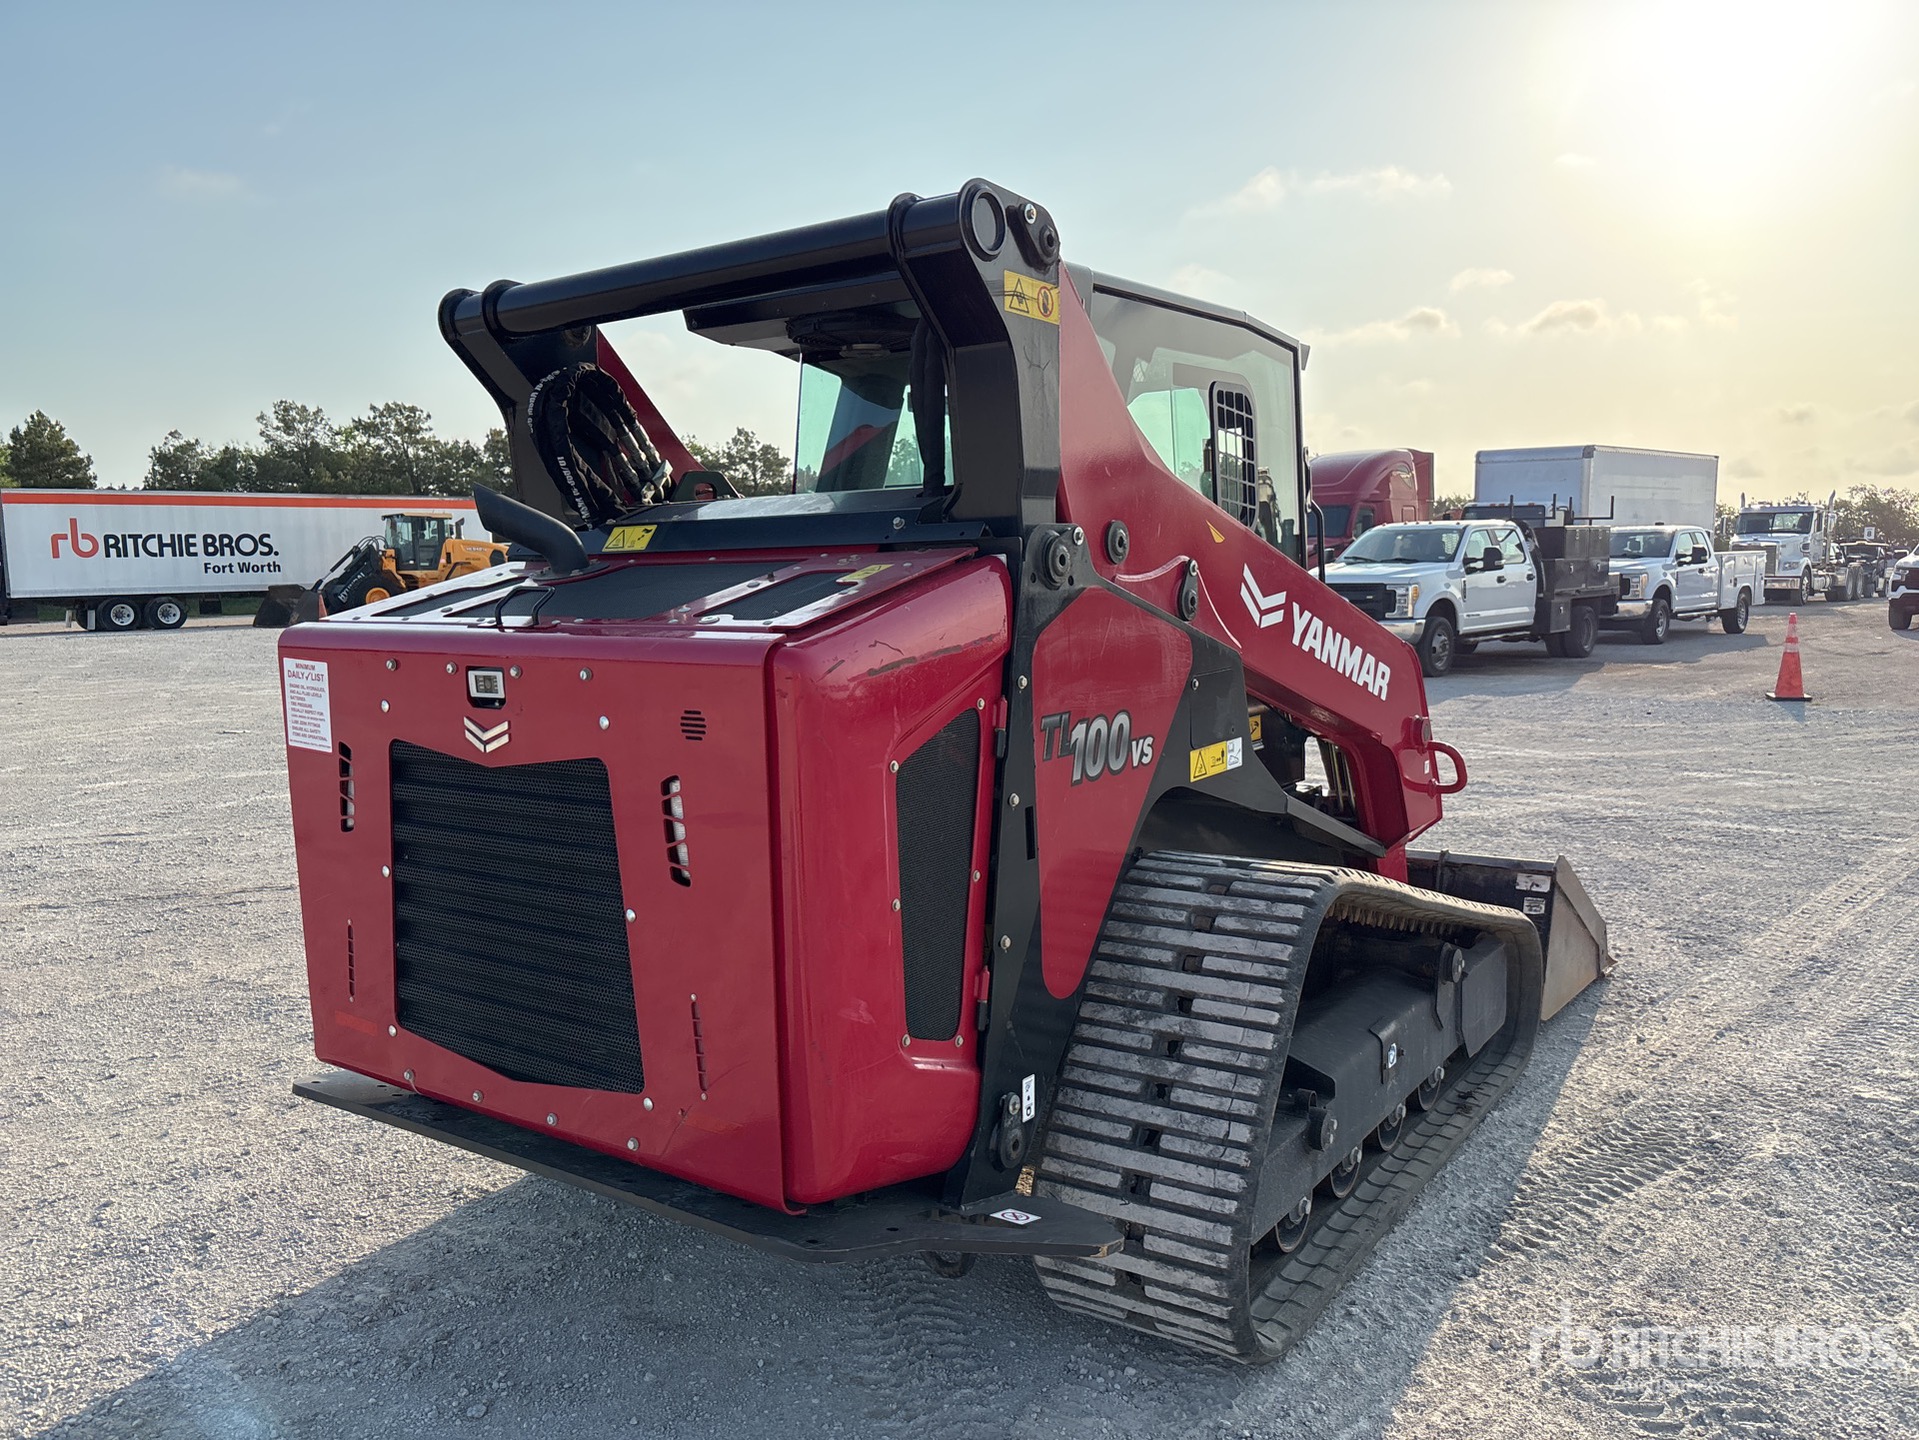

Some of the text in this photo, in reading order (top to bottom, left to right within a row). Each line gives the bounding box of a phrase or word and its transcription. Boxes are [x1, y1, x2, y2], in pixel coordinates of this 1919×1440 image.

[50, 518, 280, 559] rb RITCHIE BROS.
[204, 561, 281, 574] Fort Worth
[1291, 601, 1391, 701] YANMAR
[287, 669, 324, 682] DAILY LIST
